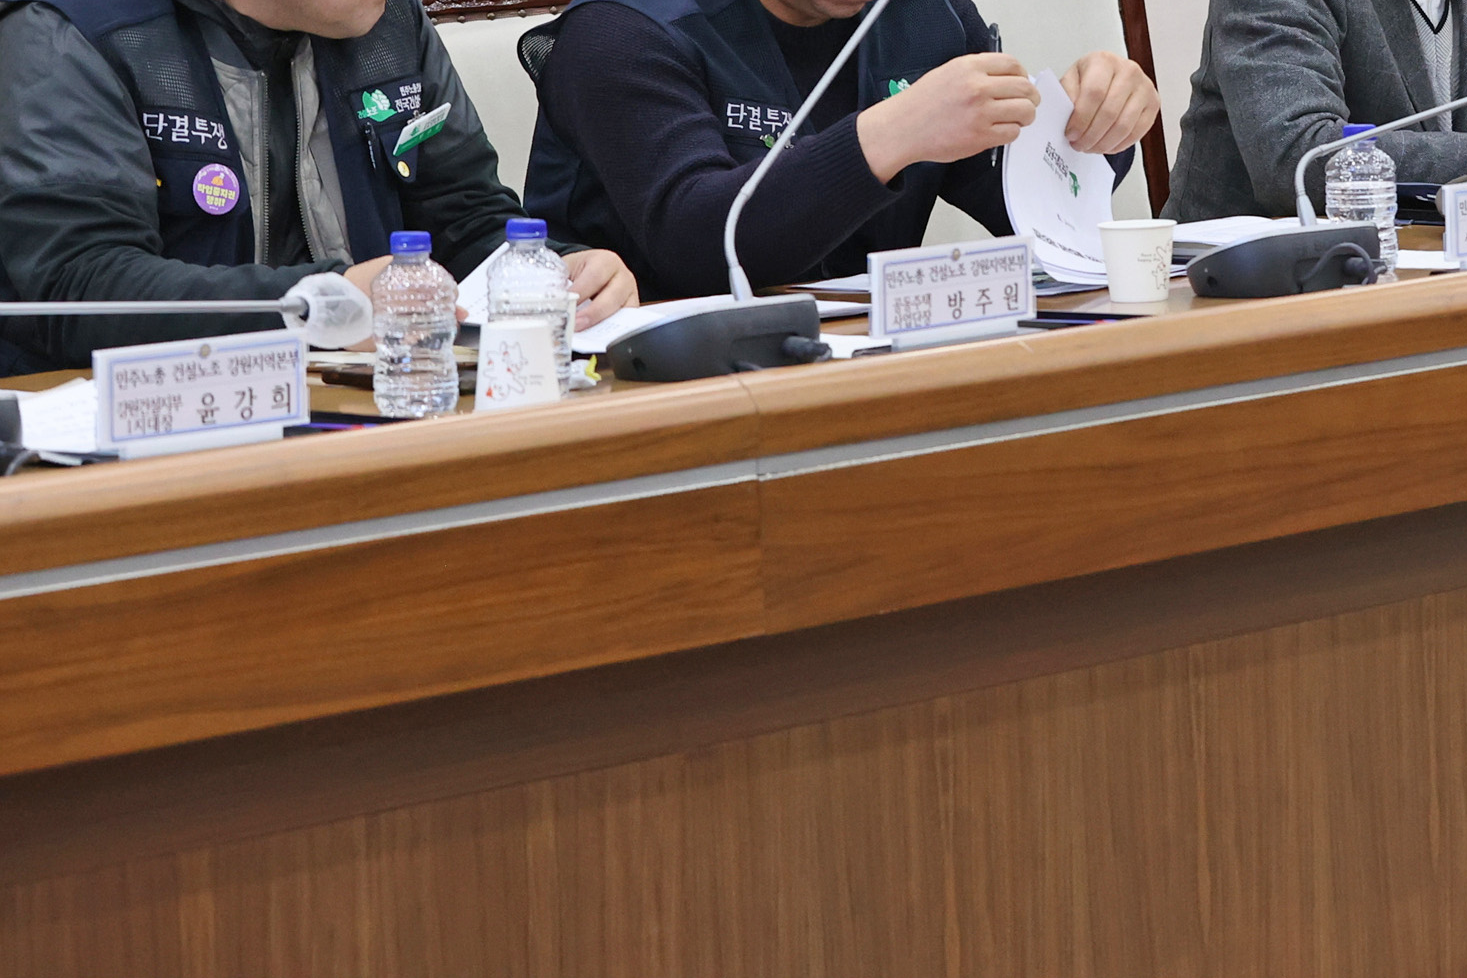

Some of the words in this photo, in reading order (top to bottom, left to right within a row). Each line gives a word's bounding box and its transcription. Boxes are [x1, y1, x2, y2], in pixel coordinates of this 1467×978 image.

[142, 113, 229, 150] 단결투쟁
[116, 366, 166, 389] 민주노총
[172, 360, 222, 383] 건설노조
[228, 350, 298, 376] 강원지역본부
